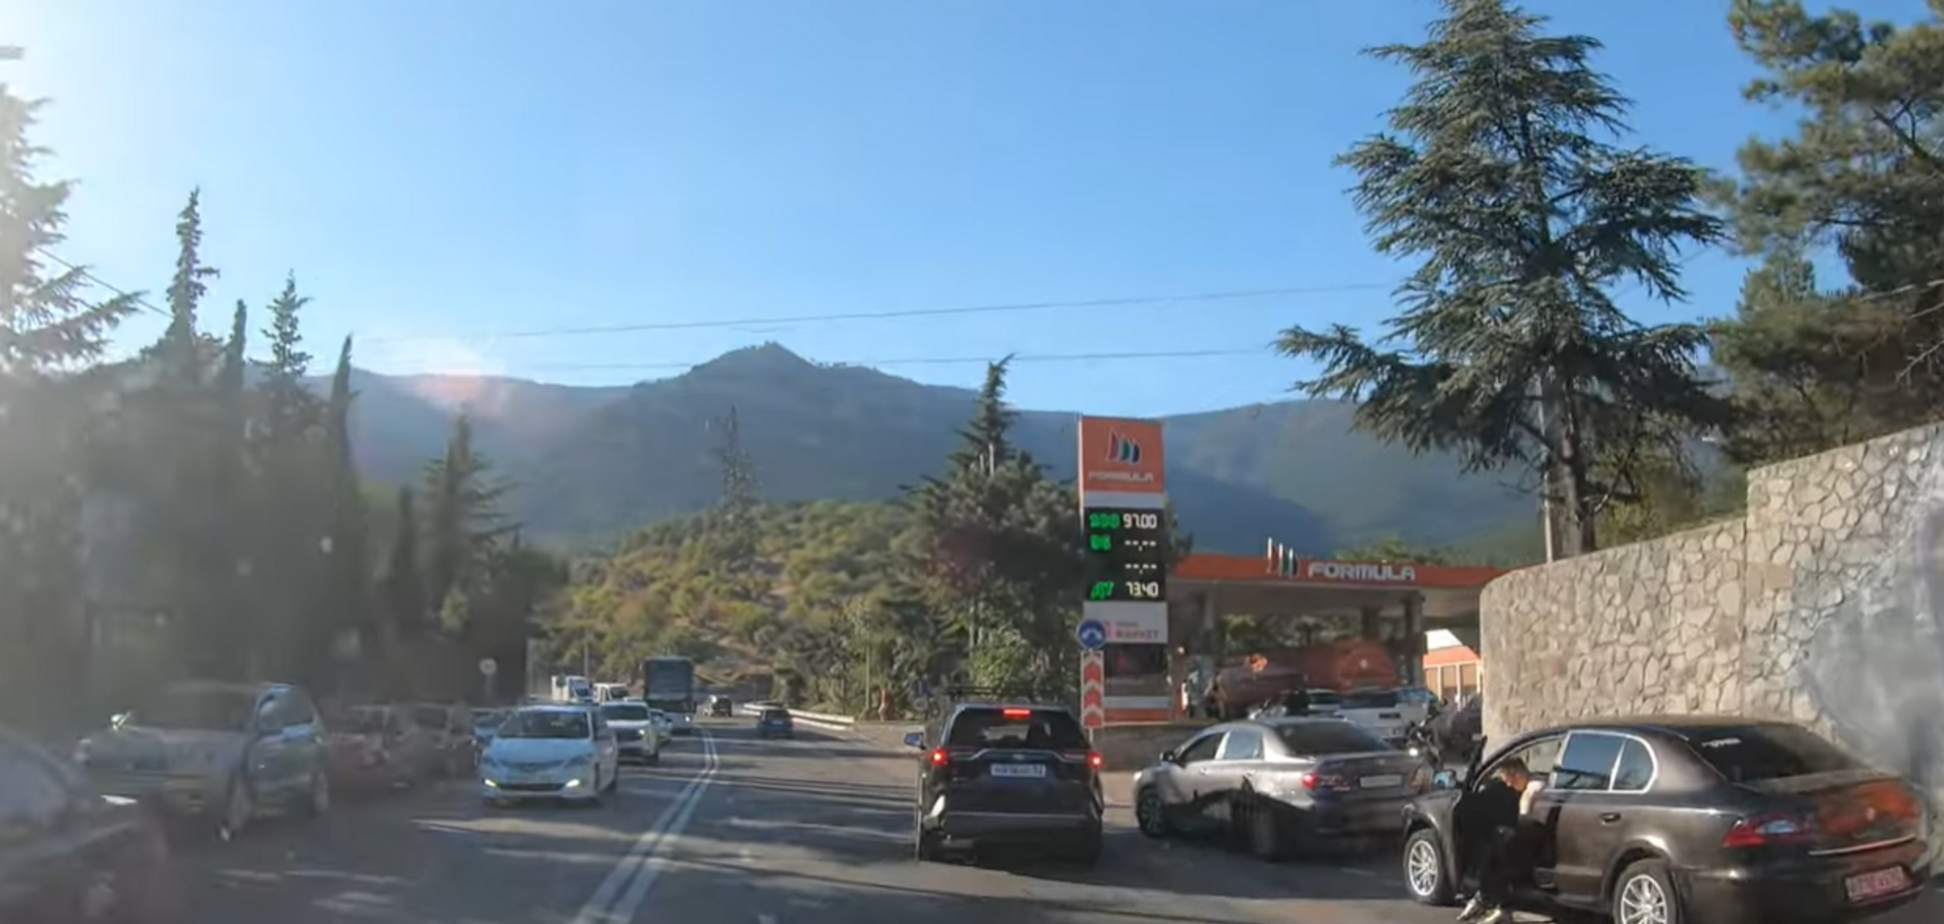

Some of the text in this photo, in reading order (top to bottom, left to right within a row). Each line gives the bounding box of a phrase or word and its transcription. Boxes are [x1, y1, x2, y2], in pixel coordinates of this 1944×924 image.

[1123, 513, 1157, 529] 97.00
[1308, 562, 1416, 581] FORMULA
[1125, 581, 1159, 597] 73.40
